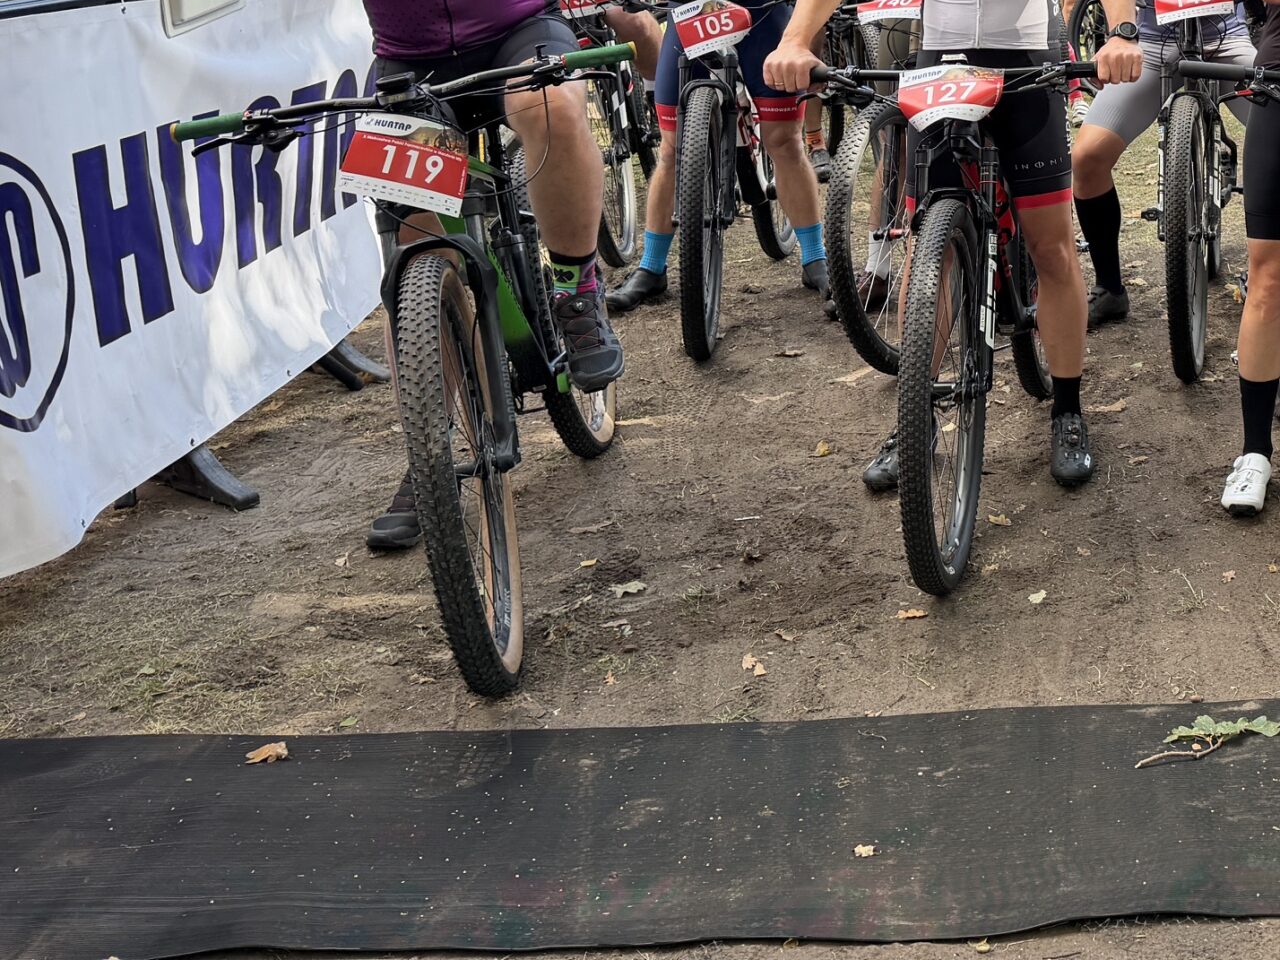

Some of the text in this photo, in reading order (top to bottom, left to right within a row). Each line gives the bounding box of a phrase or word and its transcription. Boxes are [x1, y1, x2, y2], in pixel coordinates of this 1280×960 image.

[693, 12, 734, 39] 105
[923, 81, 977, 105] 127
[374, 118, 412, 132] HURTAP
[381, 144, 444, 184] 119
[72, 58, 377, 349] HURTA
